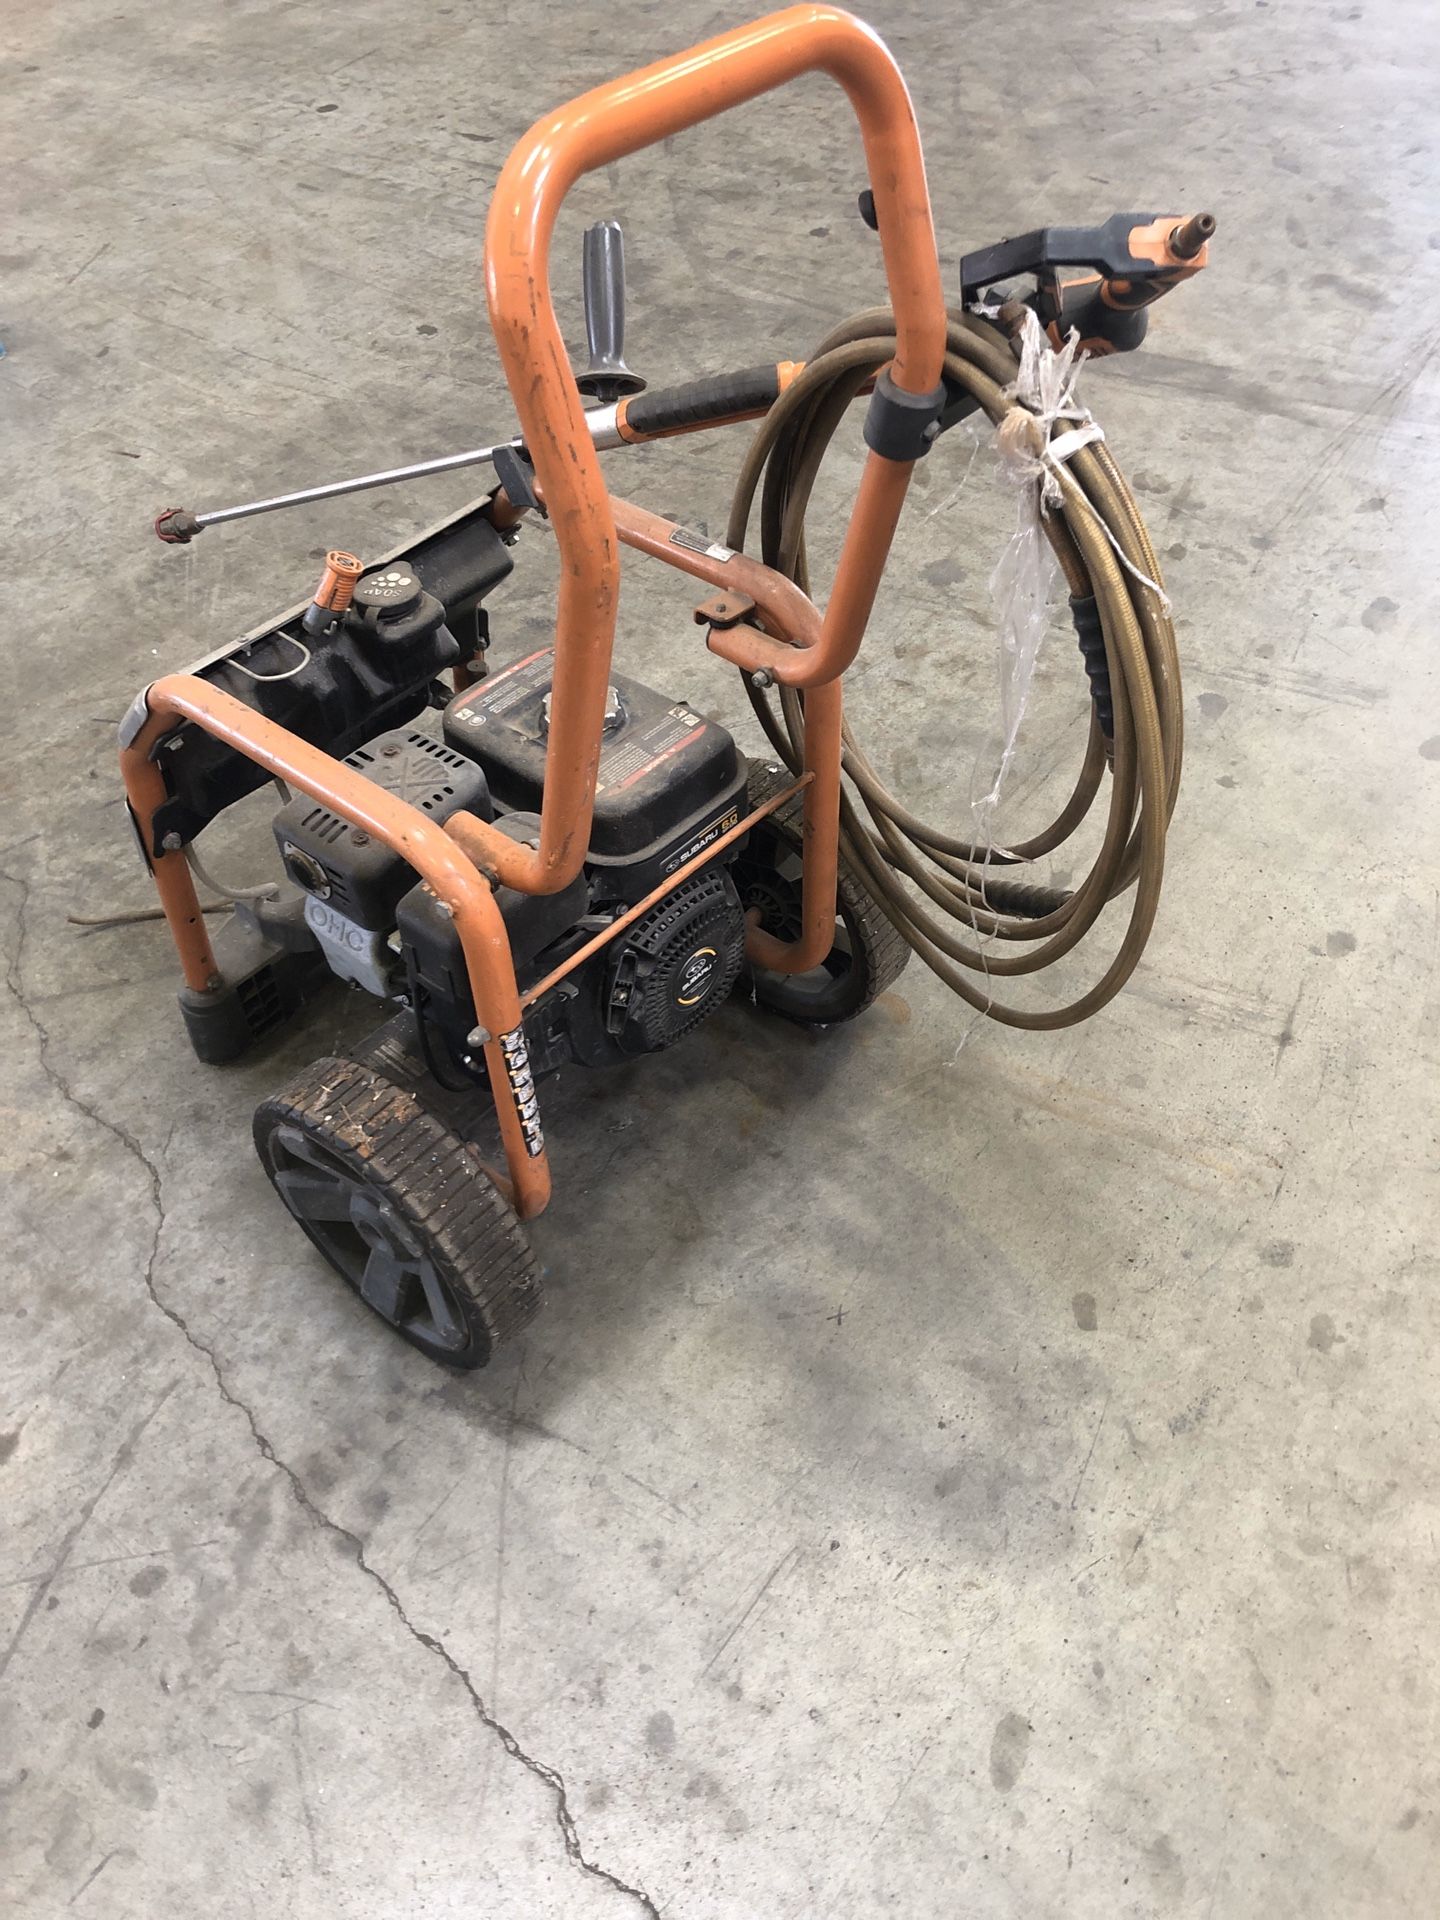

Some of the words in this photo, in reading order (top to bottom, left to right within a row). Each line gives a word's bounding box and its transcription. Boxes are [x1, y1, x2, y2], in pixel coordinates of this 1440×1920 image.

[363, 588, 402, 597] SOAP
[680, 829, 719, 862] SUBARU
[310, 905, 364, 951] OHC
[682, 964, 712, 991] SUBARU
